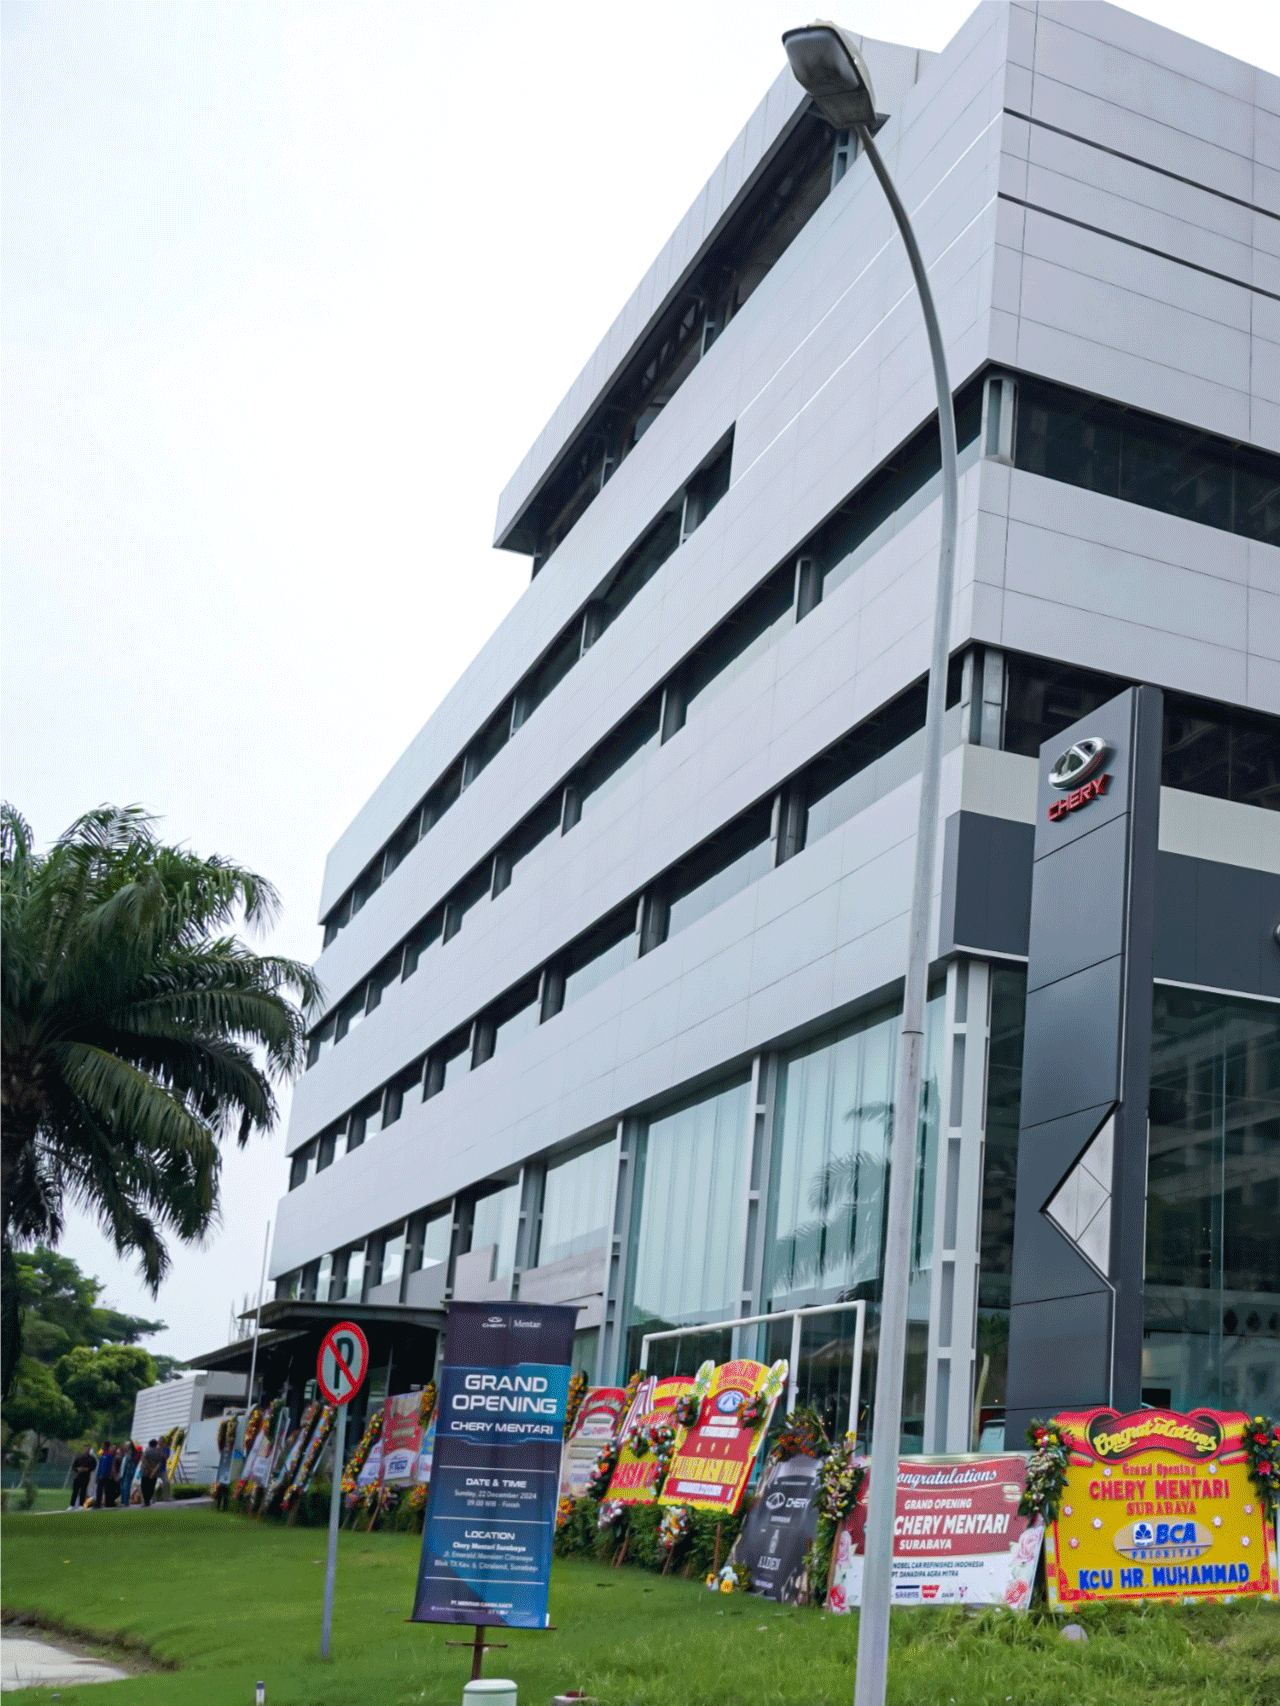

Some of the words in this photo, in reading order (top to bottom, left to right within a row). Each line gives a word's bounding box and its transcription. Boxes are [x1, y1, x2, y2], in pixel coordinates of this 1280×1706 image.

[1047, 773, 1110, 822] CHERY
[465, 1374, 548, 1393] GRAND
[452, 1394, 558, 1414] OPENING
[451, 1421, 493, 1432] CHERY
[495, 1422, 554, 1435] MENTARI
[1093, 1417, 1217, 1456] Congratulations
[897, 1467, 998, 1488] ongratulations
[1122, 1461, 1153, 1476] Grand
[1156, 1461, 1197, 1479] Opening
[466, 1477, 491, 1486] DATE
[492, 1478, 500, 1487] &
[502, 1479, 528, 1488] TIME
[1088, 1480, 1147, 1500] CHERY
[1154, 1478, 1230, 1500] MENTARI
[785, 1497, 812, 1509] CHERY
[904, 1499, 933, 1511] GRAND
[934, 1498, 973, 1510] OPENING
[1126, 1500, 1197, 1516] SURABAYA
[893, 1515, 940, 1536] CHERY
[942, 1513, 1010, 1535] MENTARI
[1155, 1522, 1197, 1545] BCA
[465, 1530, 516, 1540] LOCATION
[899, 1538, 952, 1550] SURABAYA
[1078, 1569, 1114, 1591] KCU
[1152, 1563, 1250, 1588] MUHAMMAD
